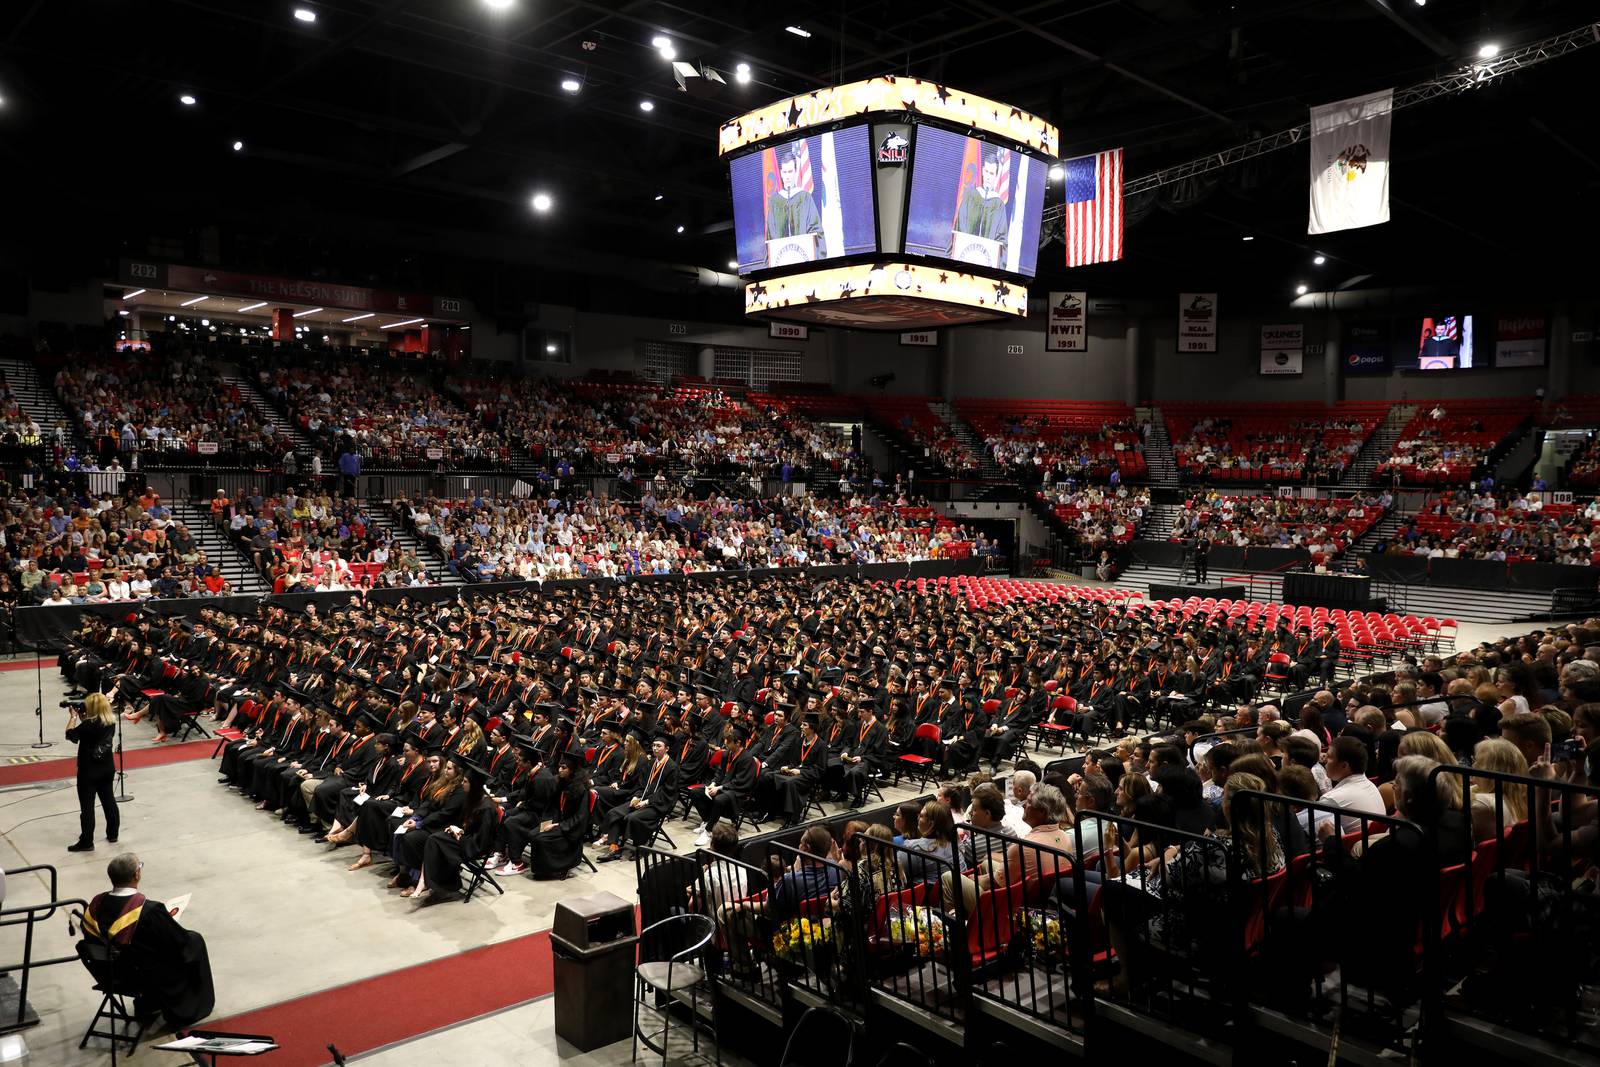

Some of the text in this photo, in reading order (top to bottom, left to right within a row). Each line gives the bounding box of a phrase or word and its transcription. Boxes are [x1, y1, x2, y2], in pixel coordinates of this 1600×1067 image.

[879, 148, 907, 159] NIU
[132, 265, 157, 278] 202
[249, 280, 276, 294] THE
[279, 281, 329, 299] NELSON
[779, 327, 800, 336] 1990
[1050, 325, 1083, 335] NWIT
[910, 334, 930, 343] 1991
[1057, 340, 1077, 348] 1991
[1188, 342, 1207, 350] 1991
[1361, 354, 1384, 365] pepsi
[1280, 488, 1292, 496] 107
[1555, 493, 1572, 502] 108
